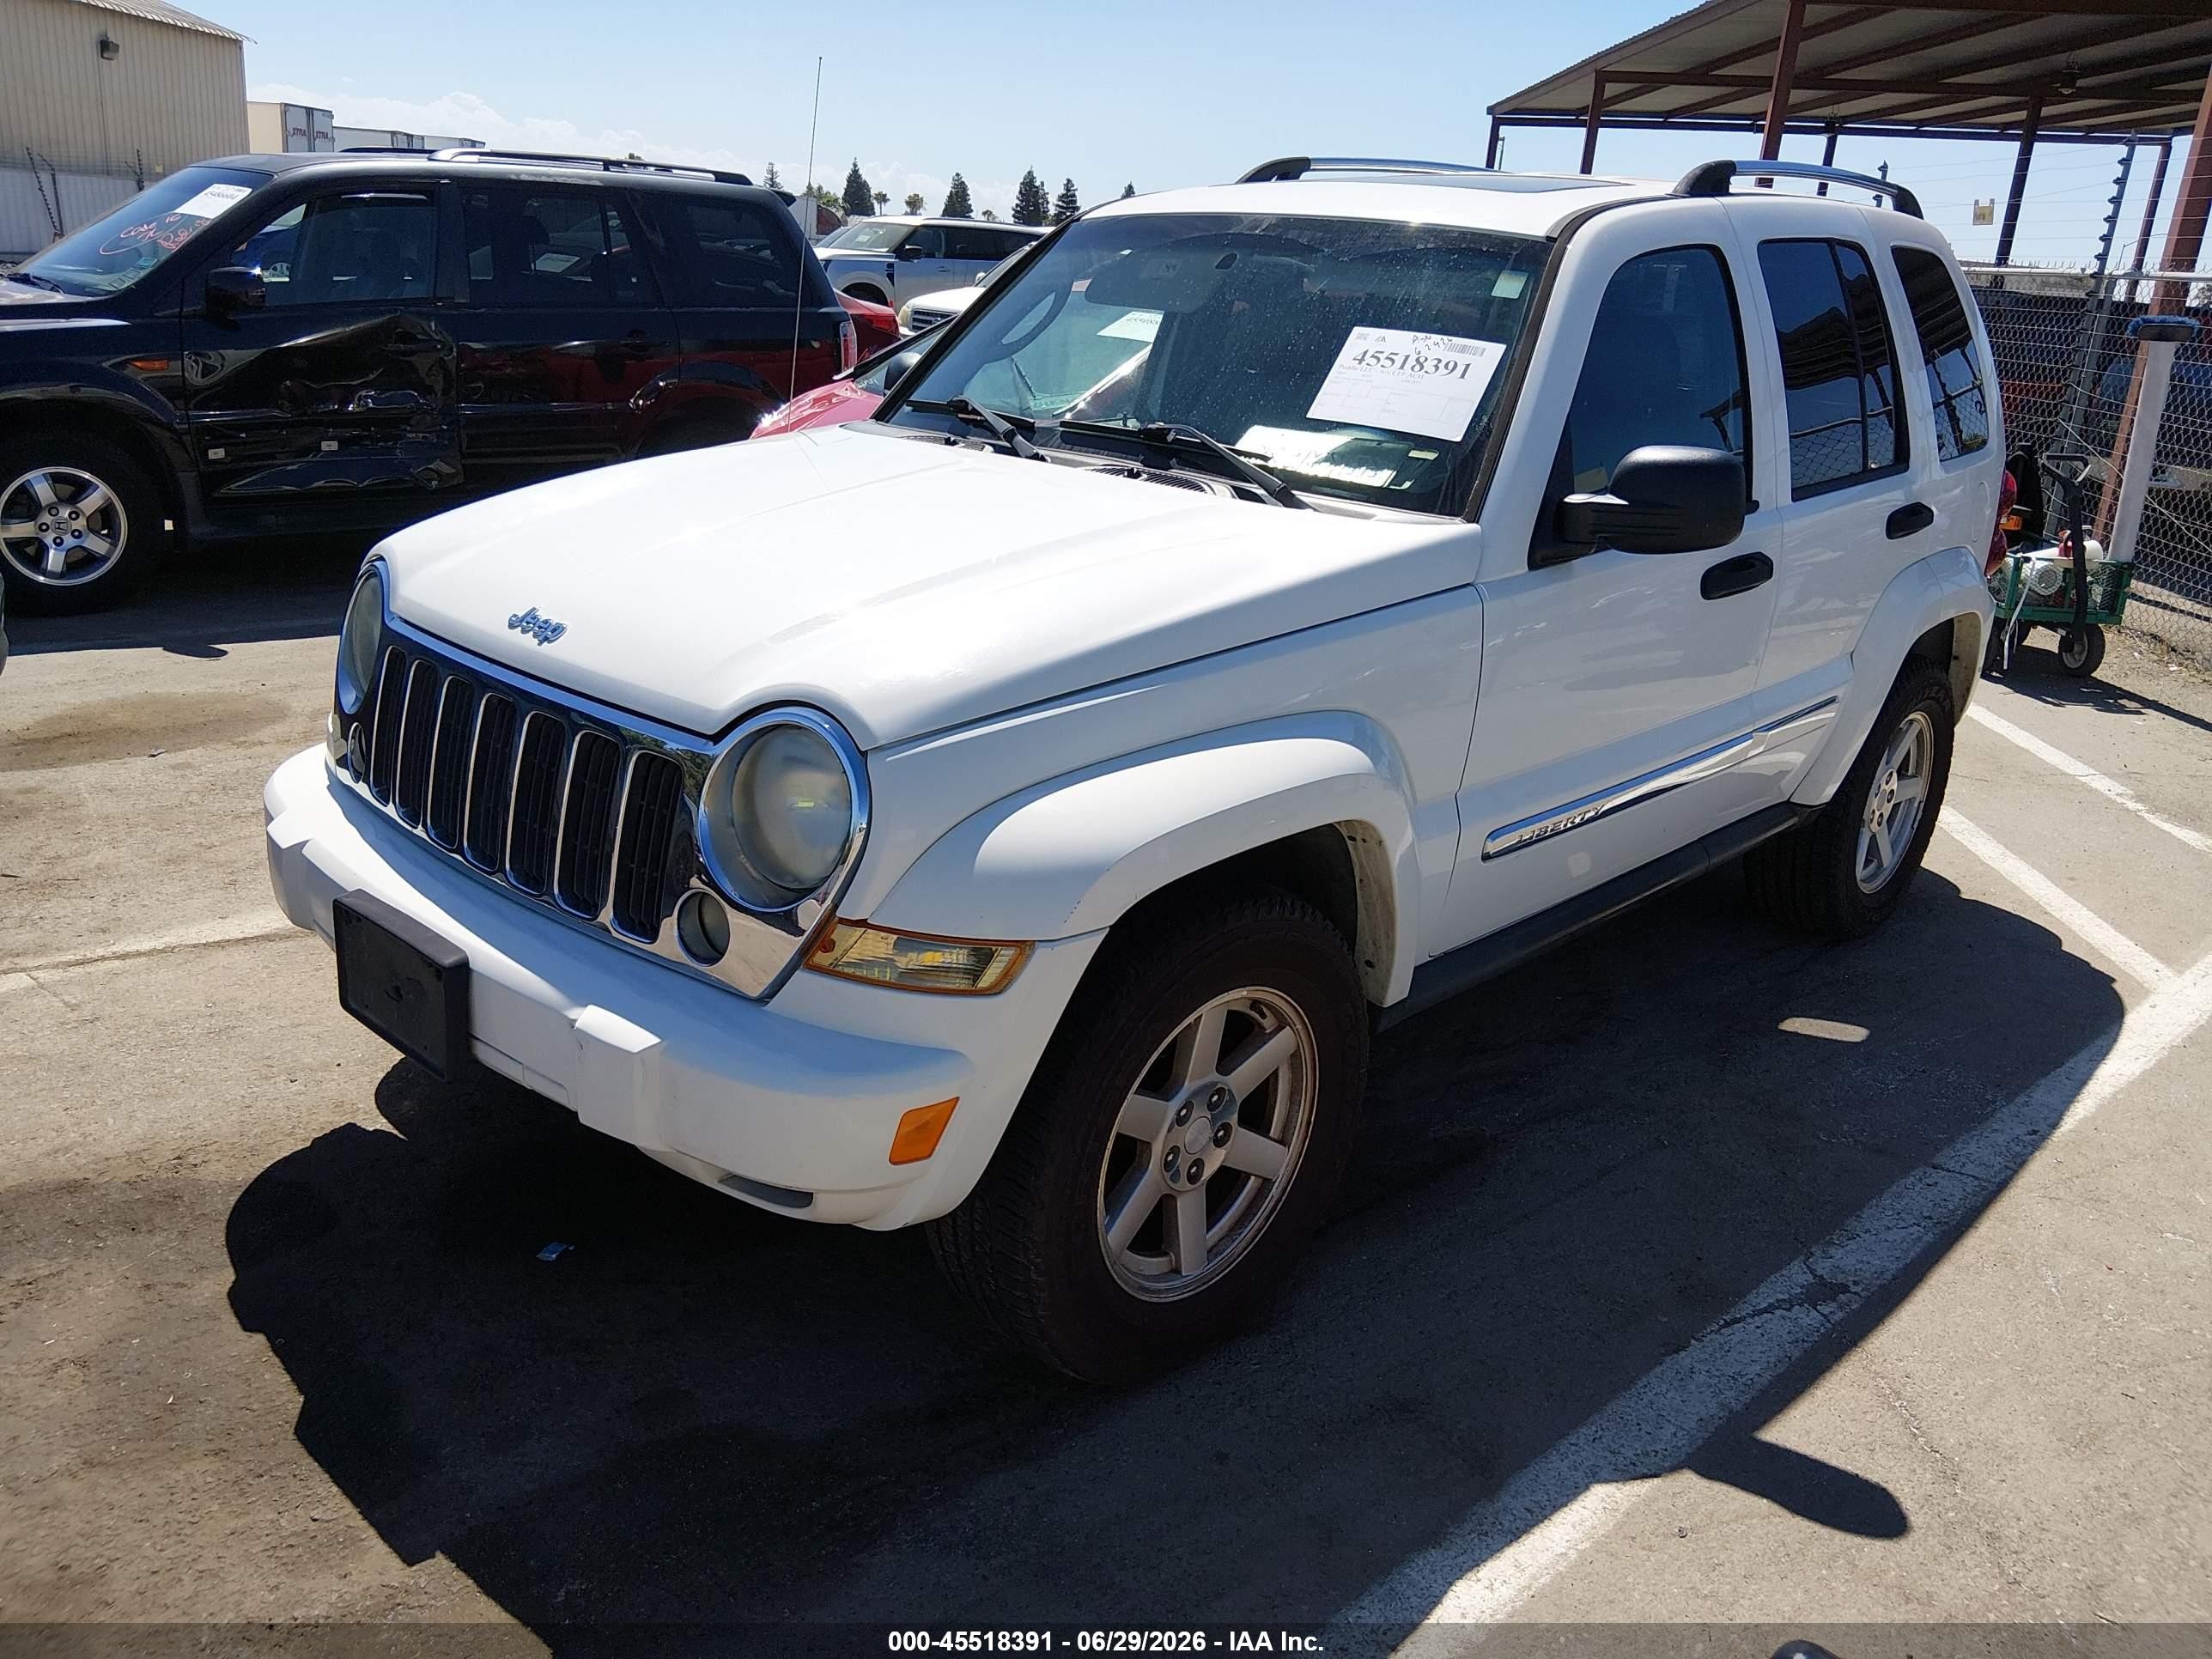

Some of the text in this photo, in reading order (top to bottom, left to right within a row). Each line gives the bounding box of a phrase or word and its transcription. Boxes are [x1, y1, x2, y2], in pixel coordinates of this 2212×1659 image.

[1352, 349, 1472, 380] 45518391
[508, 607, 568, 646] Jeep
[1516, 804, 1606, 844] LIBERTY
